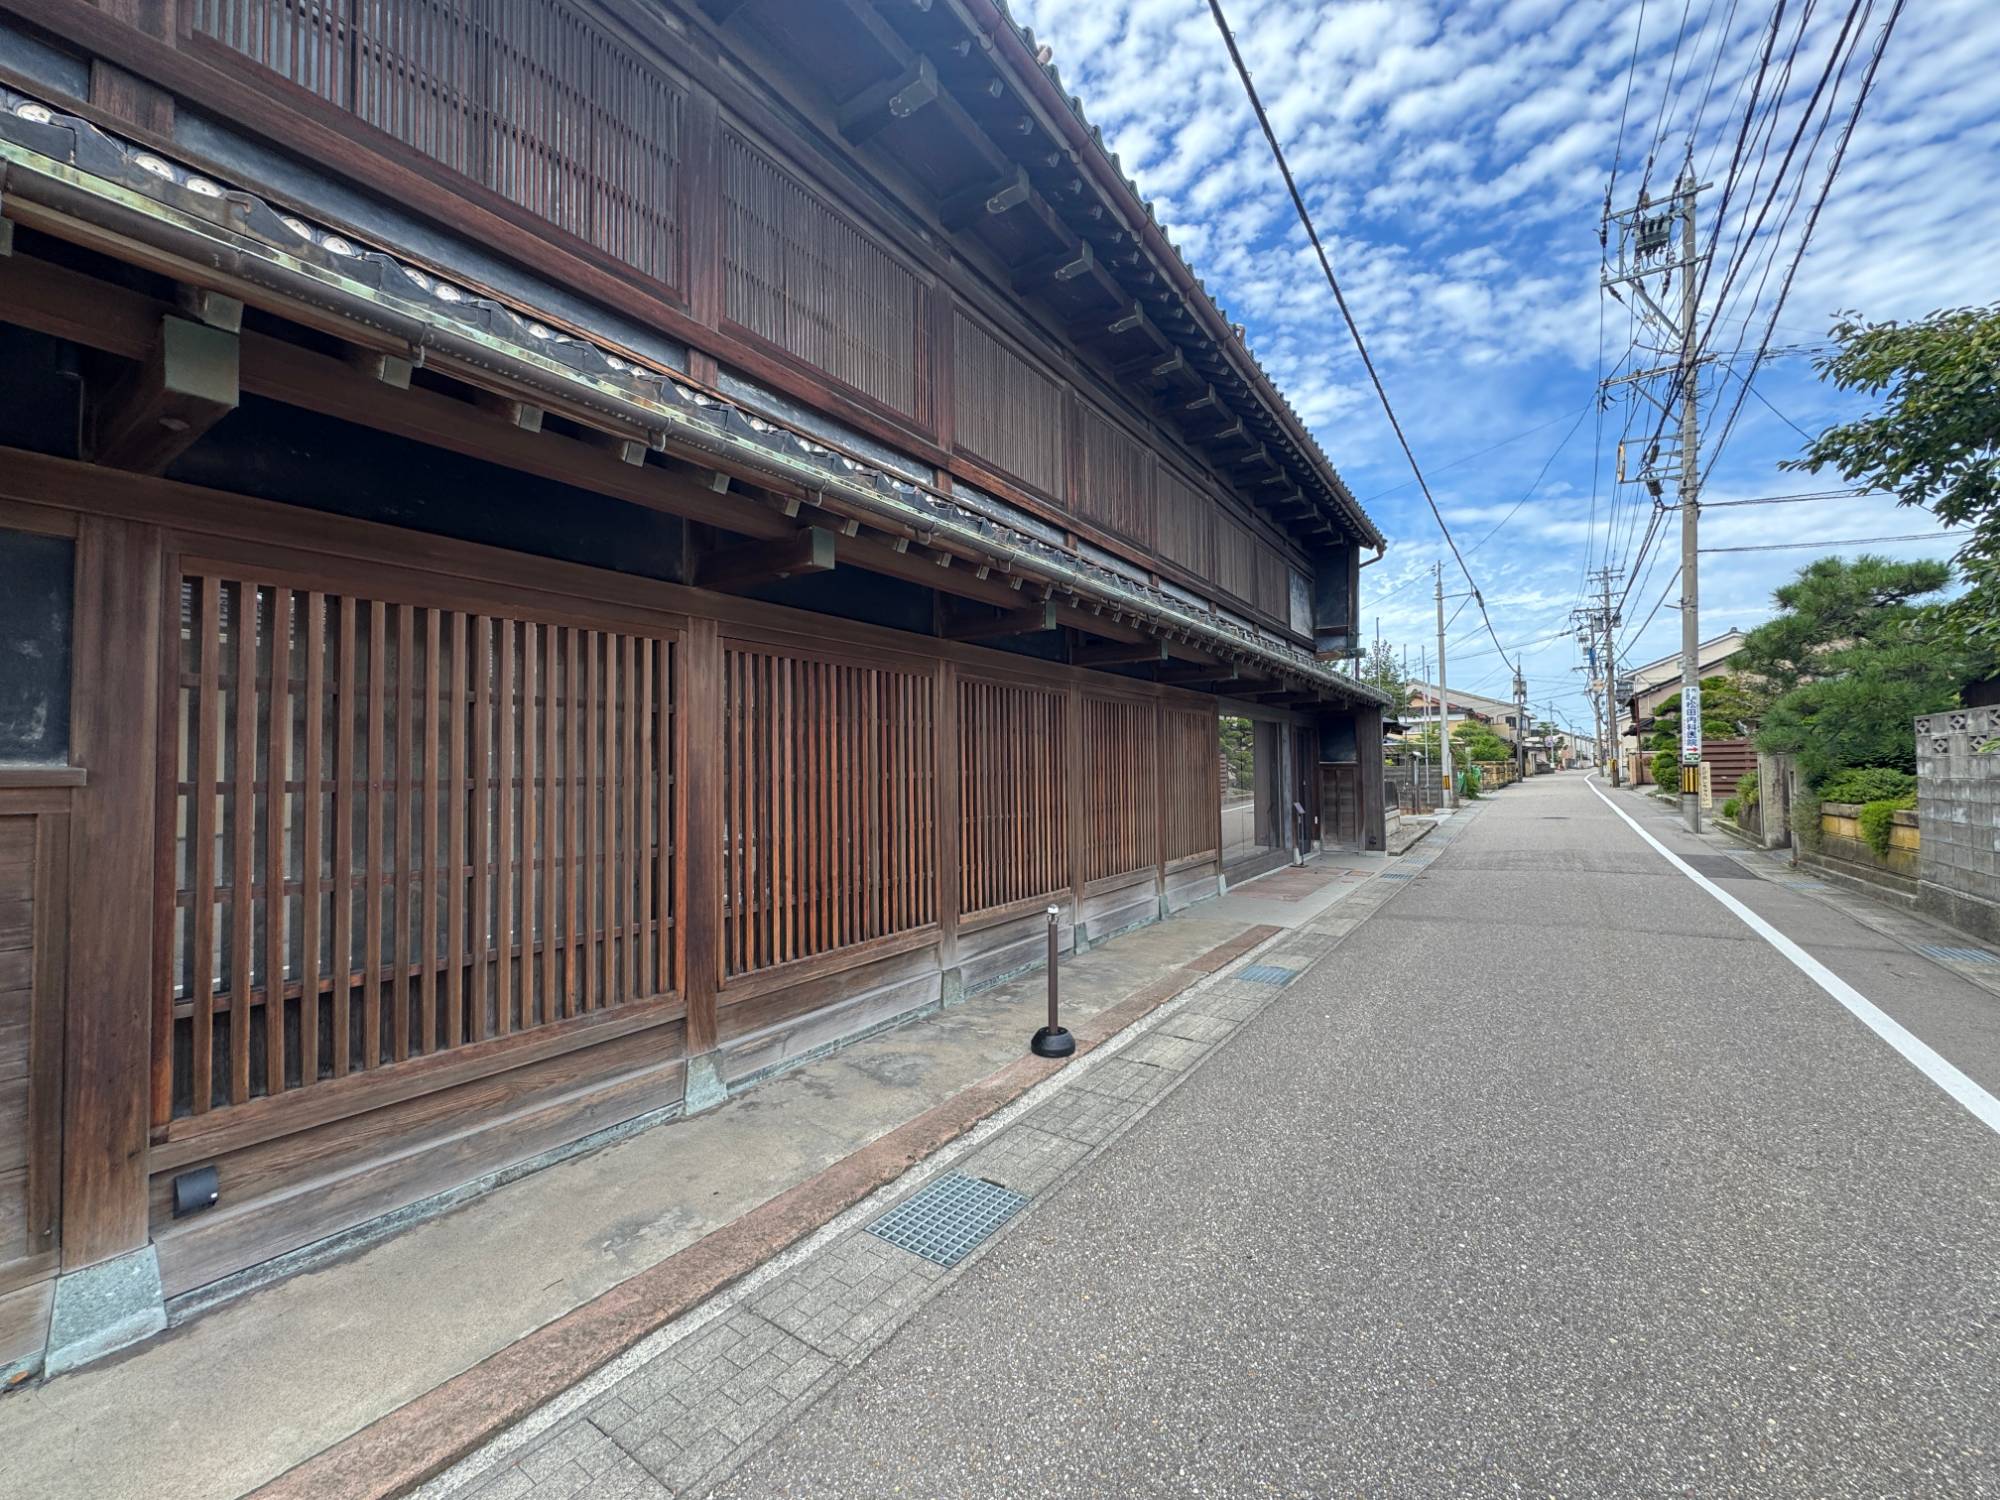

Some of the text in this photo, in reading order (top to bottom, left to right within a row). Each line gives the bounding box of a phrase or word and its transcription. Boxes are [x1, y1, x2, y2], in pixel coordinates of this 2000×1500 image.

[1686, 700, 1697, 746] 松田内科医院
